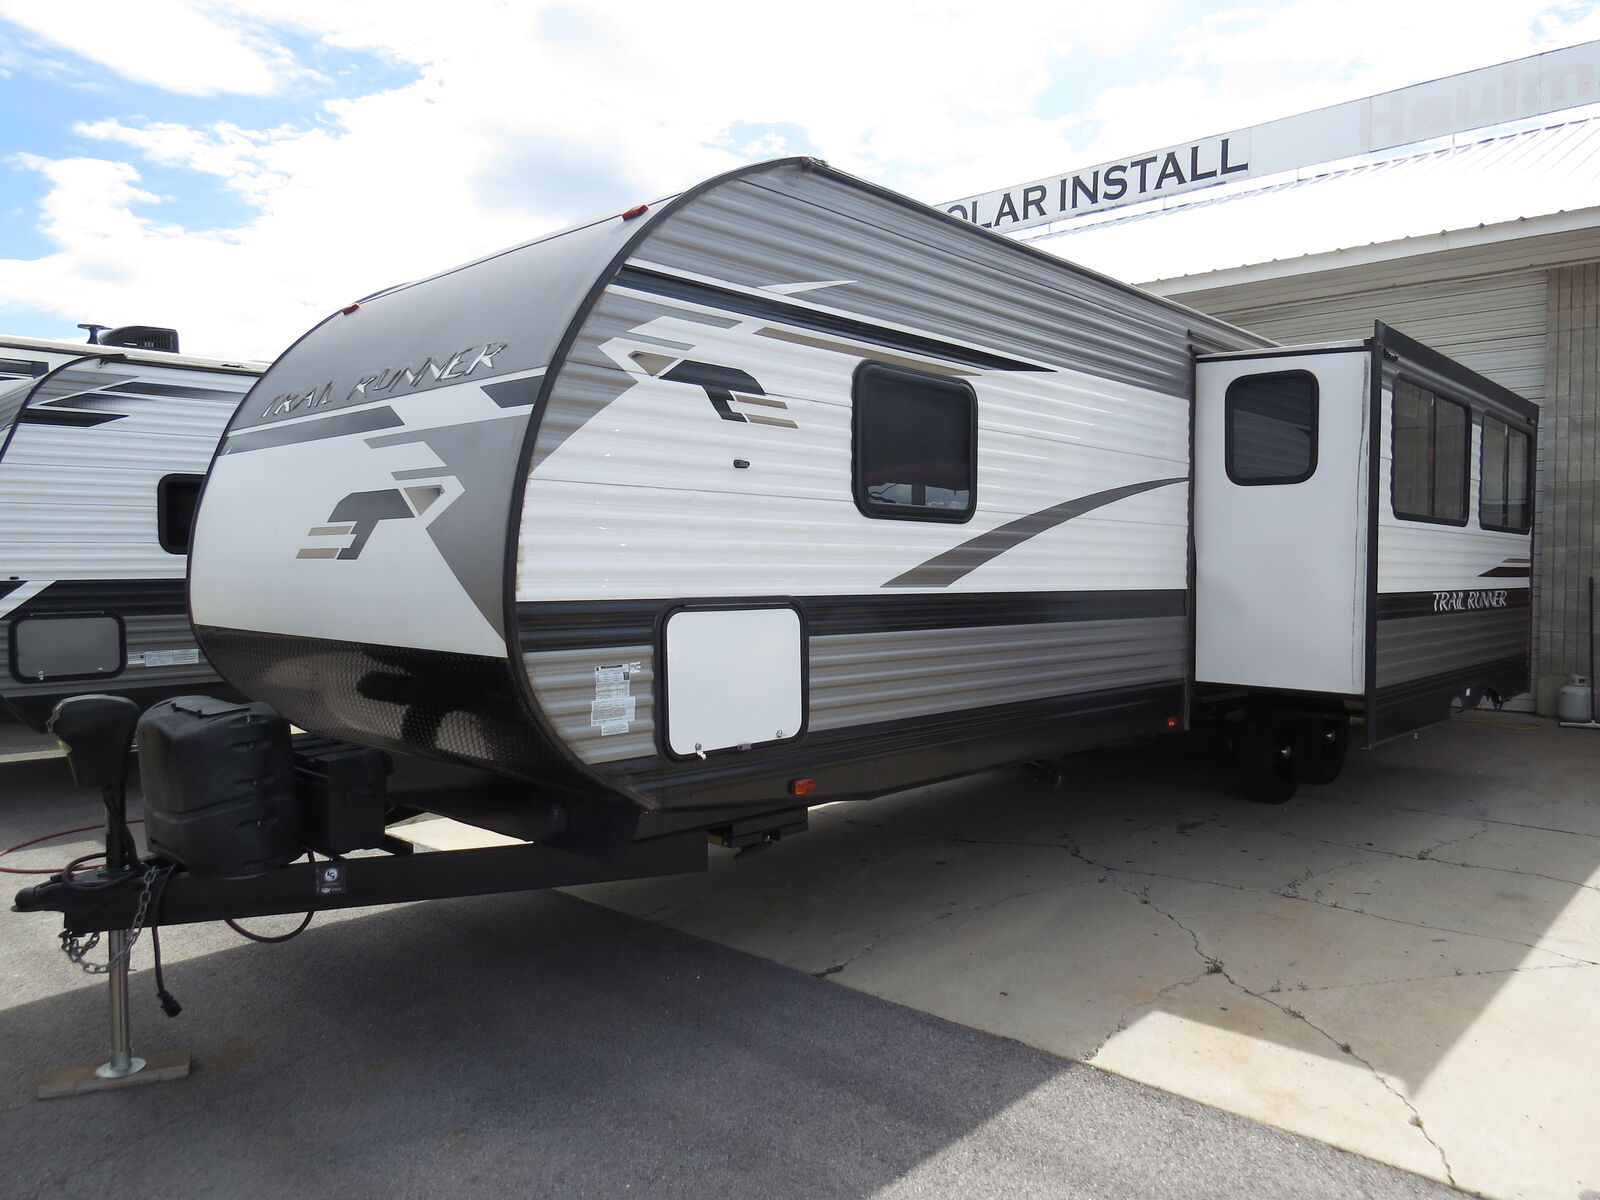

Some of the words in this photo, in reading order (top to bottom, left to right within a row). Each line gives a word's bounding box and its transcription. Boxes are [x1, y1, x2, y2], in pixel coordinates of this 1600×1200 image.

[1359, 61, 1600, 147] Haulm
[1058, 137, 1249, 212] INSTALL
[261, 380, 334, 418] TRAIL
[346, 342, 508, 400] RUNNER
[1432, 591, 1466, 612] TRAIL
[1467, 590, 1508, 609] RUNNER
